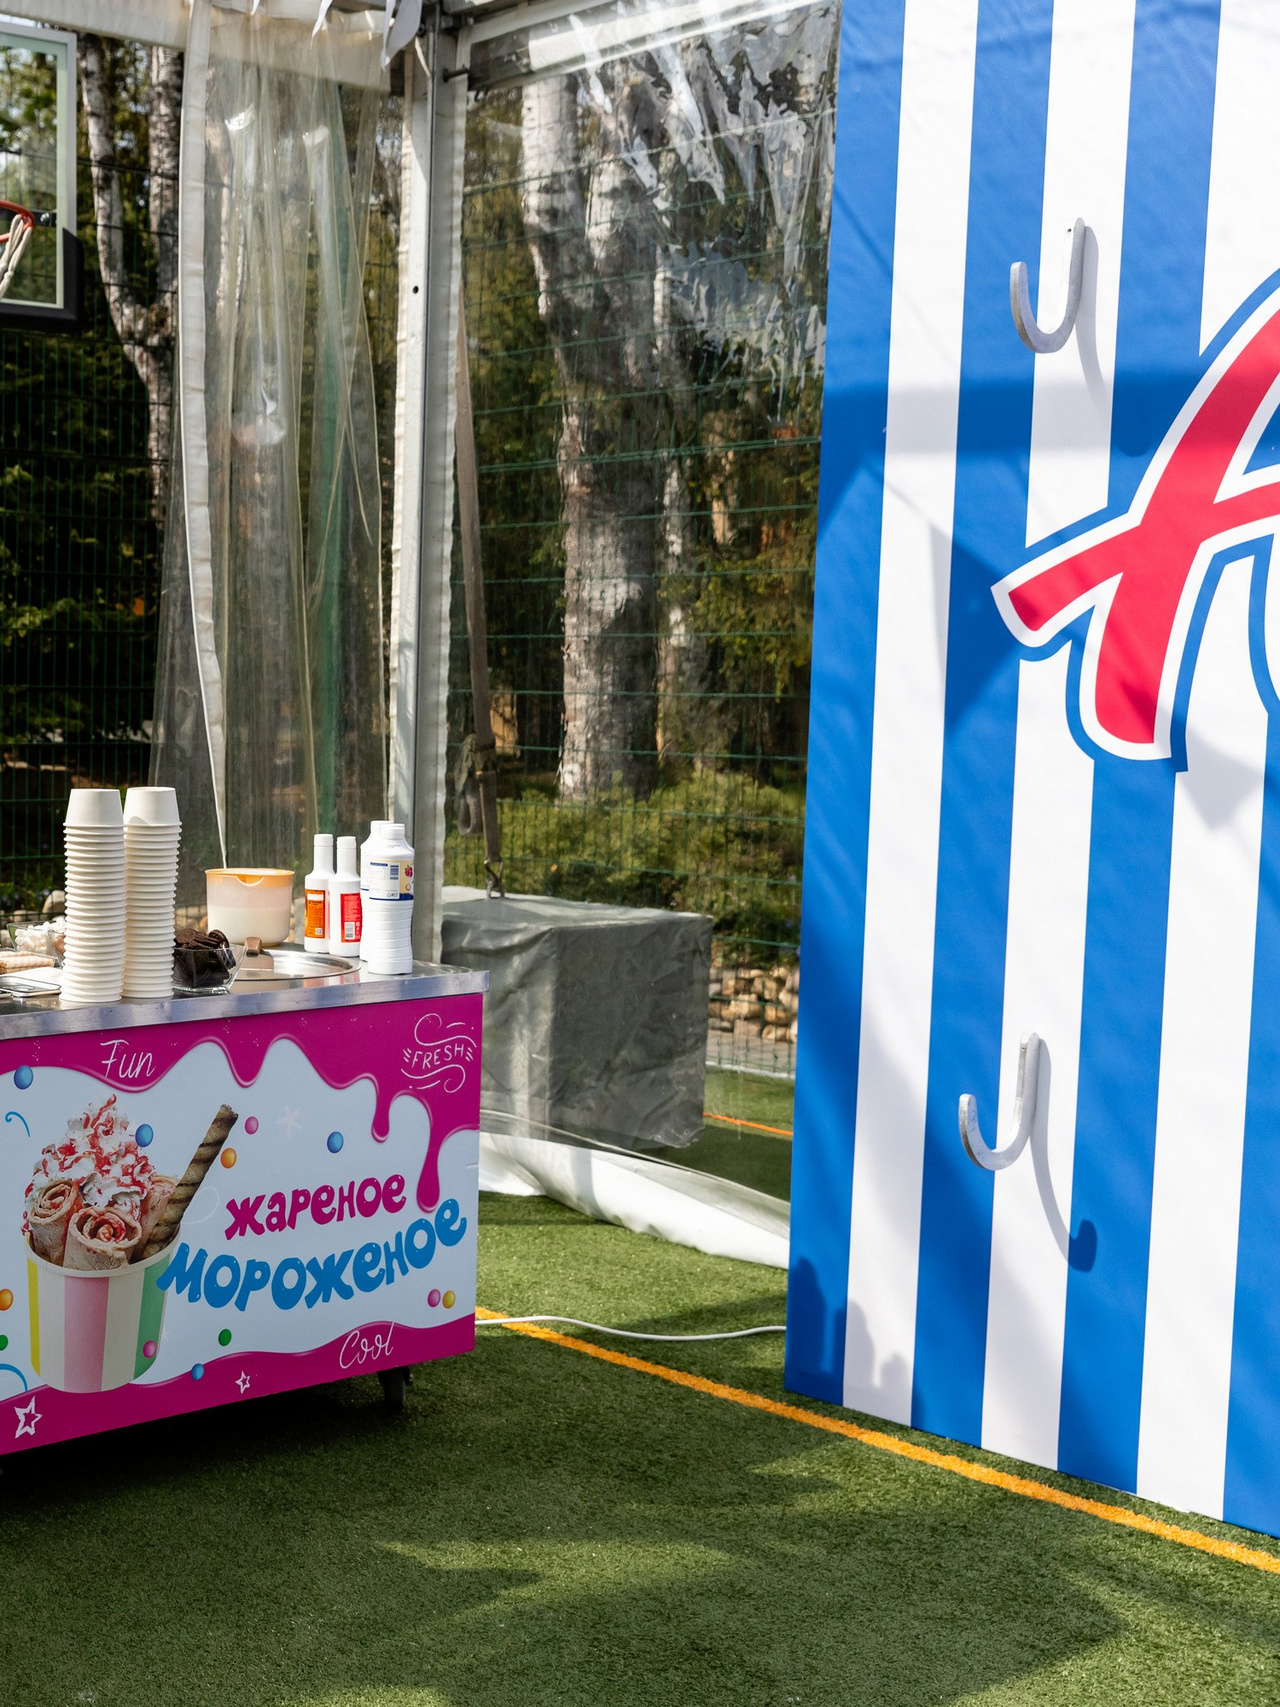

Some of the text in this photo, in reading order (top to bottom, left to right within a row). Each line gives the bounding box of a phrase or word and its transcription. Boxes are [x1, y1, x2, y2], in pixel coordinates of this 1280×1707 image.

[100, 1039, 156, 1078] Fun
[411, 1043, 464, 1069] FRESH
[339, 1321, 394, 1369] Cool
